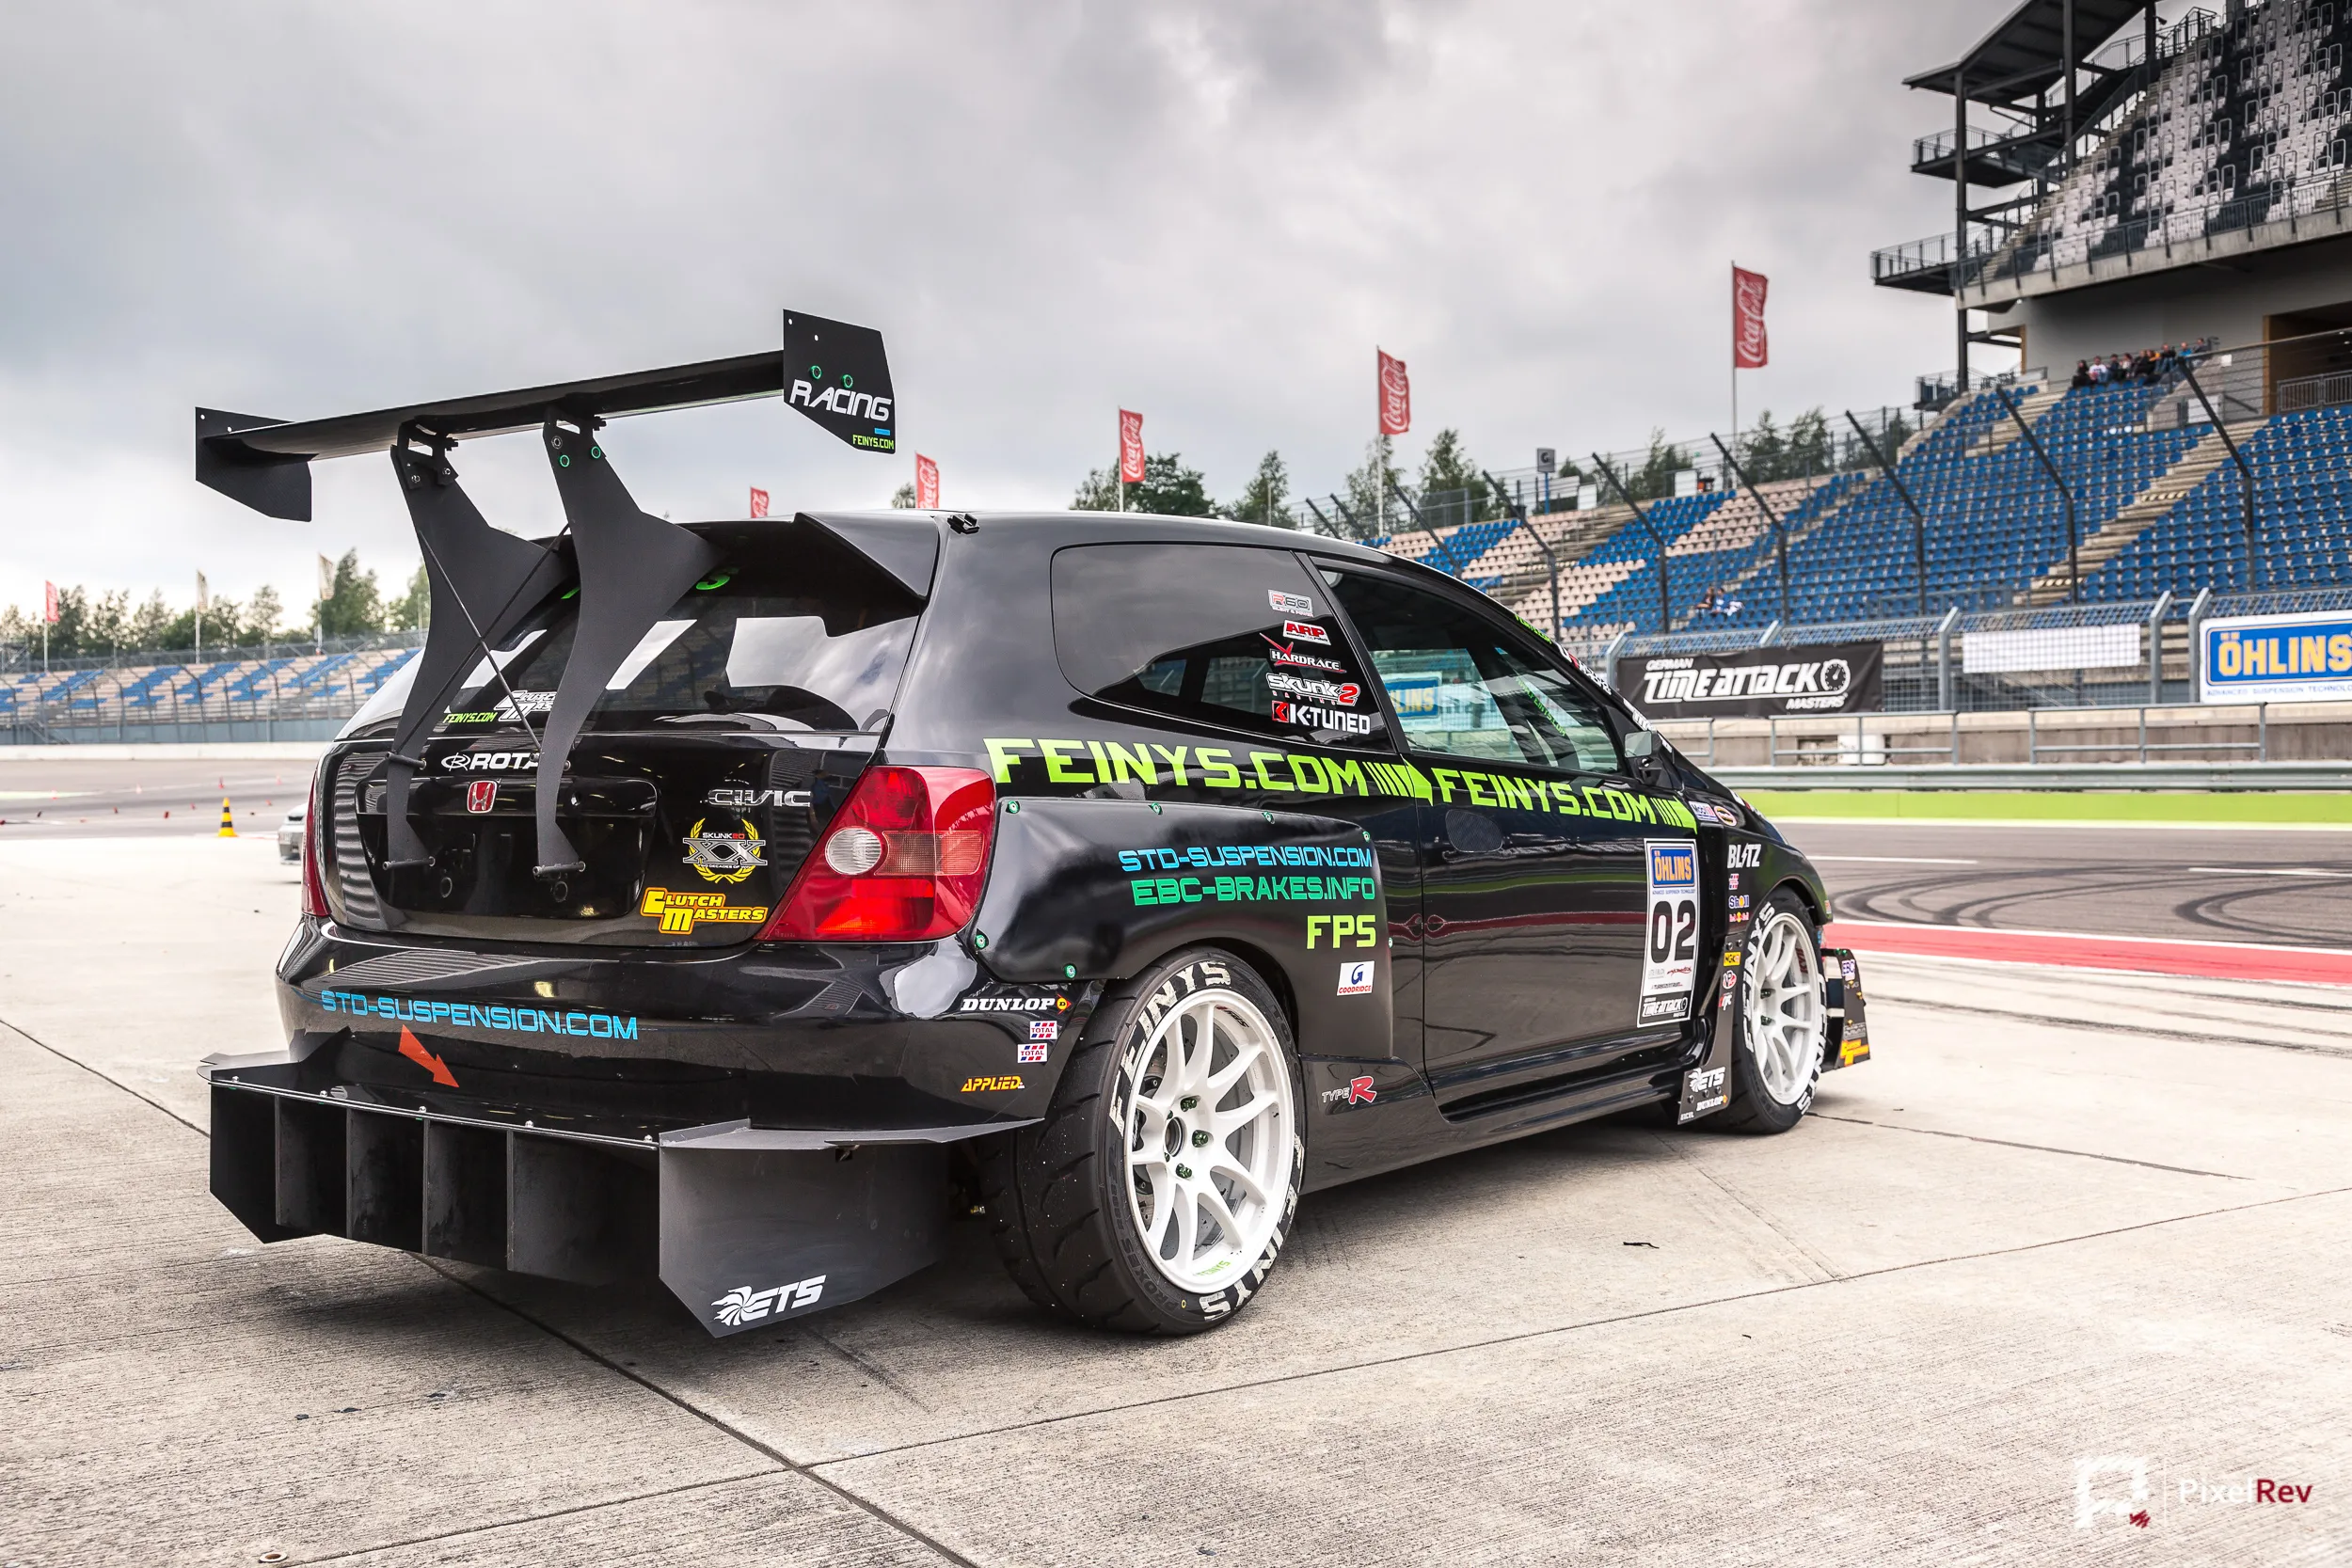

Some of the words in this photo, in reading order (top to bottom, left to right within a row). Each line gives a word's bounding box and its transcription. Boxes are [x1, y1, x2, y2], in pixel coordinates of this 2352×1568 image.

[788, 378, 893, 421] RACING
[852, 434, 895, 450] FEINYS.COM
[1286, 623, 1325, 638] ARP
[1271, 650, 1341, 671] HARDRACE
[1646, 657, 1693, 671] GERMAN
[2218, 631, 2352, 676] ÖHLINS
[1786, 696, 1846, 710] MASTERS
[442, 712, 498, 724] FEINYS.COM
[1290, 704, 1371, 735] K-TUNED
[983, 737, 1370, 797] FEINYS.COM
[707, 789, 811, 807] CIVIC
[1431, 768, 1658, 825] FEINYS.COM
[1118, 847, 1374, 872] STD-SUSPENSION.COM
[1654, 850, 1692, 882] ÖHLINS
[644, 890, 723, 914] CLUTCH
[1131, 877, 1375, 906] EBC-BRAKES.INFO
[661, 908, 765, 931] MASTERS
[1307, 915, 1376, 949] FPS
[1650, 900, 1696, 963] 02
[1338, 985, 1372, 994] GOODRIDGE
[321, 990, 638, 1040] STD-SUSPENSION.COM
[960, 998, 1056, 1011] DUNLOP
[1109, 960, 1232, 1139] FEINYS
[961, 1075, 1023, 1092] APPLIED
[1322, 1086, 1350, 1102] TYPE
[1348, 1076, 1377, 1104] R
[740, 1274, 826, 1322] ETS
